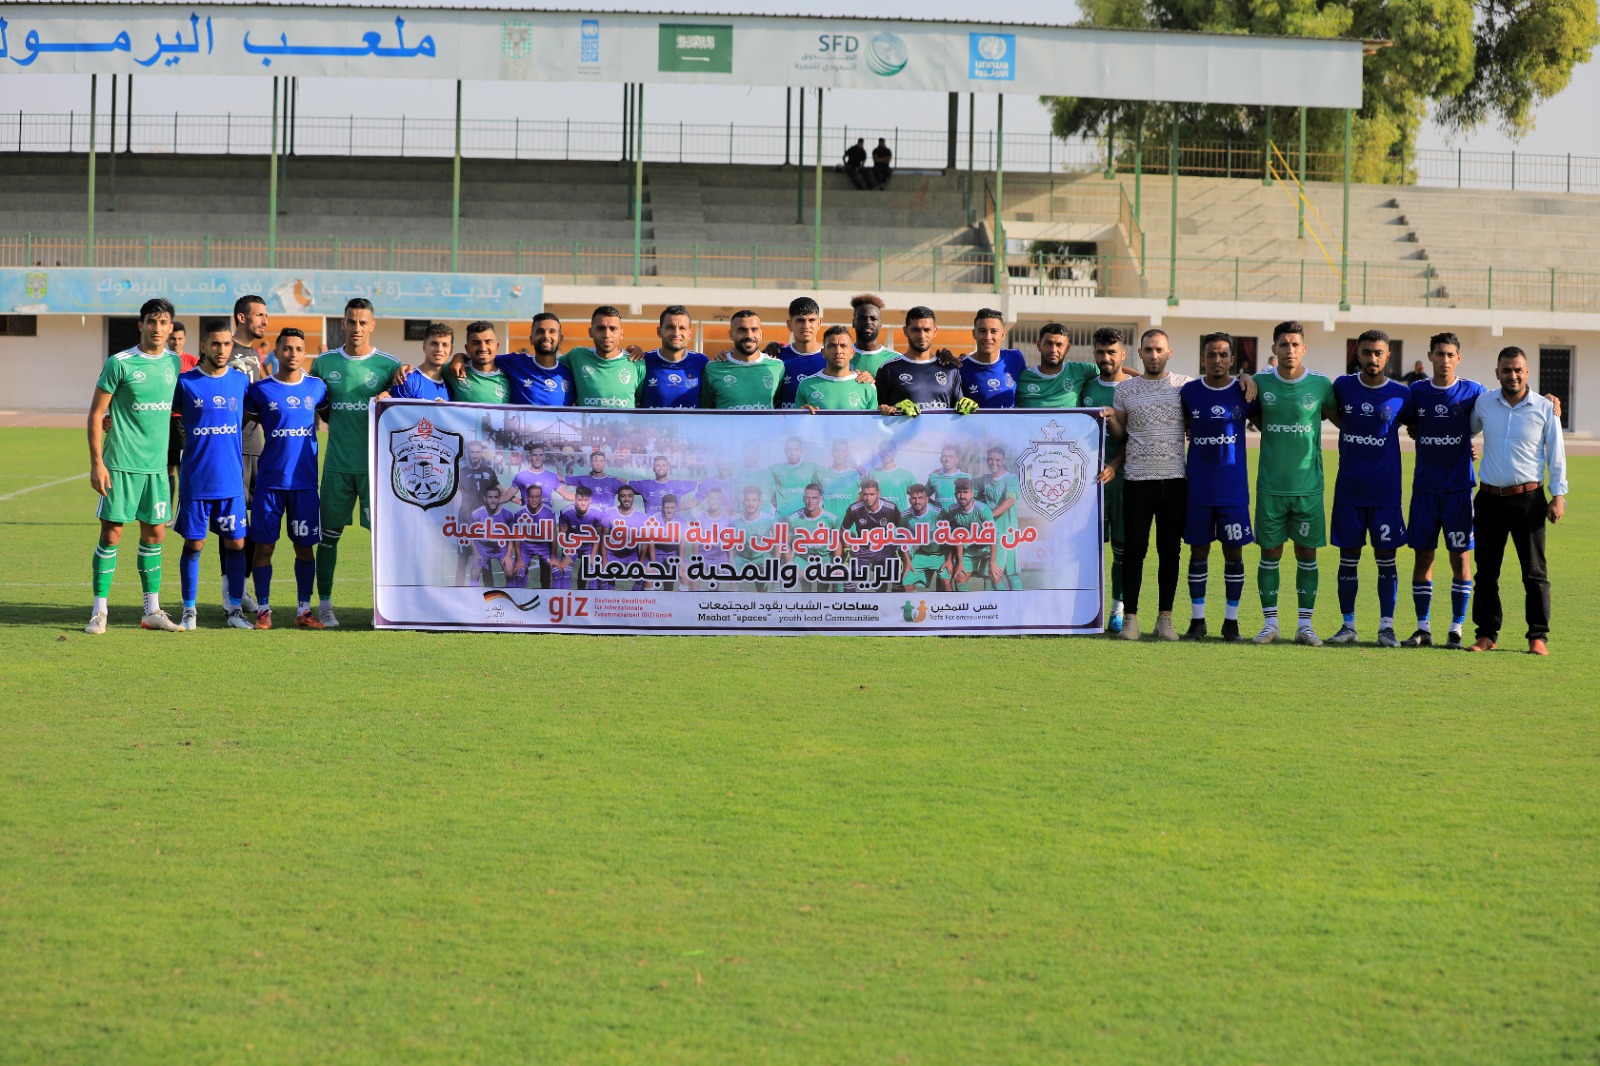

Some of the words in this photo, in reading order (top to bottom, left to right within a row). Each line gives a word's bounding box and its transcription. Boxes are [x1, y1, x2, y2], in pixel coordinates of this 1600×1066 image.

[243, 15, 436, 67] ملعب
[818, 34, 859, 53] SFD
[173, 278, 226, 297] ملعب
[332, 400, 369, 411] ooredo
[585, 395, 630, 407] ooredoo
[193, 423, 238, 436] ooredoo
[1267, 422, 1313, 434] ooredoo
[1194, 433, 1238, 446] ooredoo
[1420, 434, 1463, 446] ooredoo
[154, 501, 167, 520] 17
[218, 514, 237, 532] 27
[291, 519, 309, 537] 16
[442, 514, 553, 546] الشجاعية
[1224, 523, 1243, 540] 18
[1299, 522, 1310, 538] 8
[558, 526, 599, 554] حي
[605, 517, 679, 549] الشرق
[686, 521, 745, 550] بوابة
[751, 523, 787, 553] إلى
[793, 523, 839, 553] رفح
[844, 522, 928, 550] الجنوب
[935, 521, 995, 545] قلعة
[1002, 526, 1037, 548] من
[1379, 524, 1391, 541] 2
[1448, 531, 1467, 548] 12
[582, 555, 680, 587] تجمعنا
[687, 555, 797, 588] والمحبة
[805, 556, 899, 588] الرياضة
[548, 592, 589, 624] giz
[699, 601, 756, 612] المجتمعات
[759, 600, 783, 612] يقود
[785, 600, 821, 612] الشباب
[832, 602, 879, 611] مساحات
[930, 602, 969, 613] للتمكين
[972, 602, 997, 612] نفس
[698, 613, 731, 621] Msahat
[779, 614, 801, 623] youth
[825, 613, 880, 622] Communities
